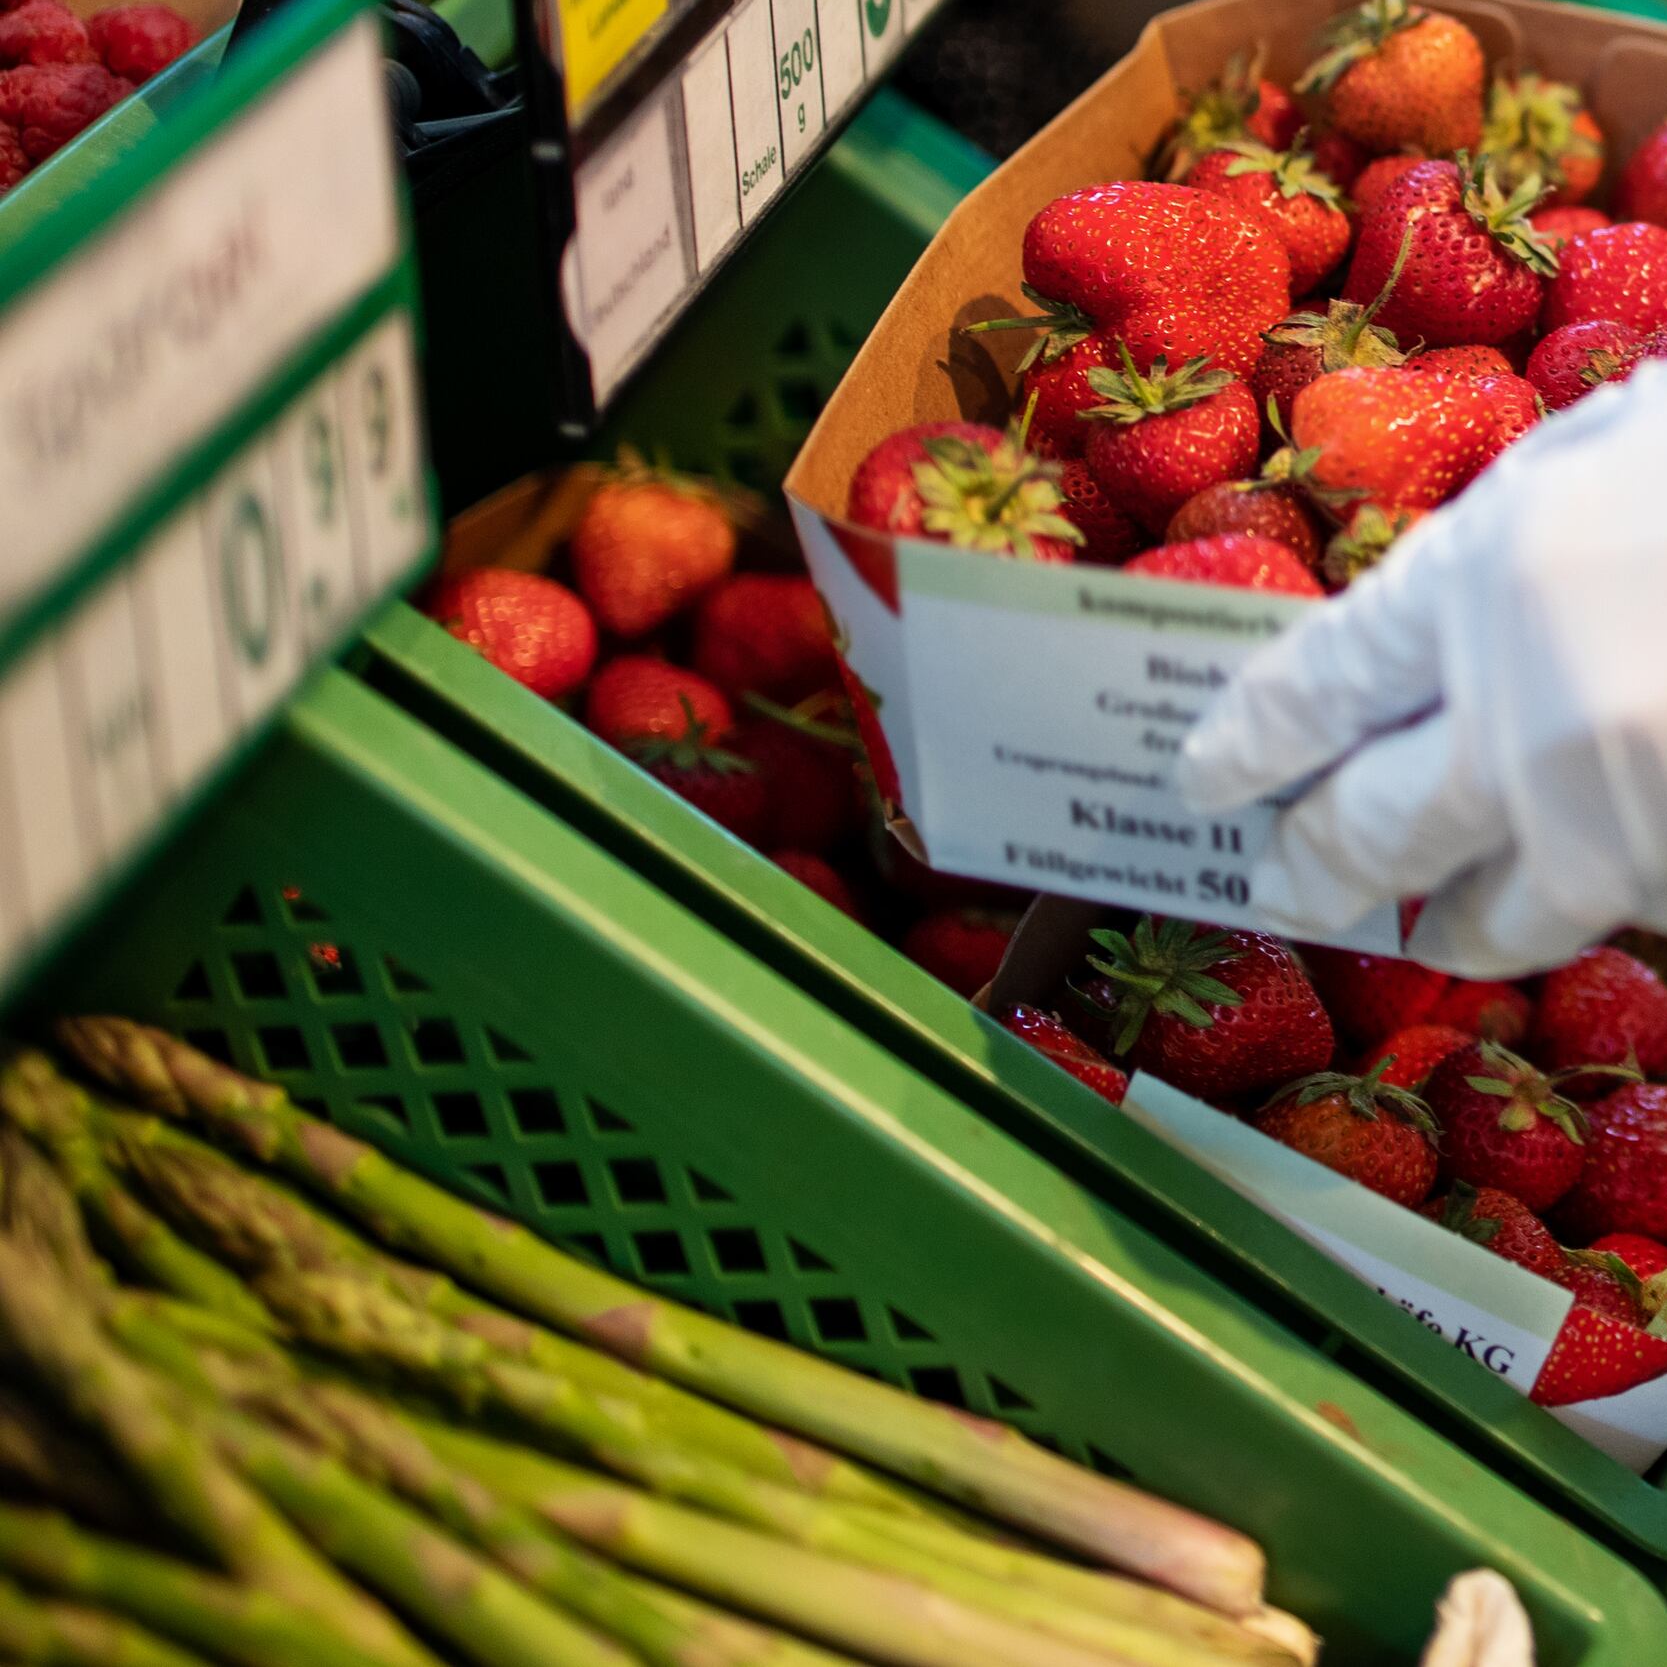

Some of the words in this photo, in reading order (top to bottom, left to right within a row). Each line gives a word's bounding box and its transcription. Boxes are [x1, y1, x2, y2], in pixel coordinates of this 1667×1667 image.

[779, 27, 814, 101] 500
[797, 101, 806, 134] g
[742, 144, 777, 197] Schale
[1070, 798, 1197, 847] Klasse
[1210, 822, 1244, 855] II
[1005, 841, 1187, 895] Füllgewicht
[1455, 1327, 1516, 1375] KG
